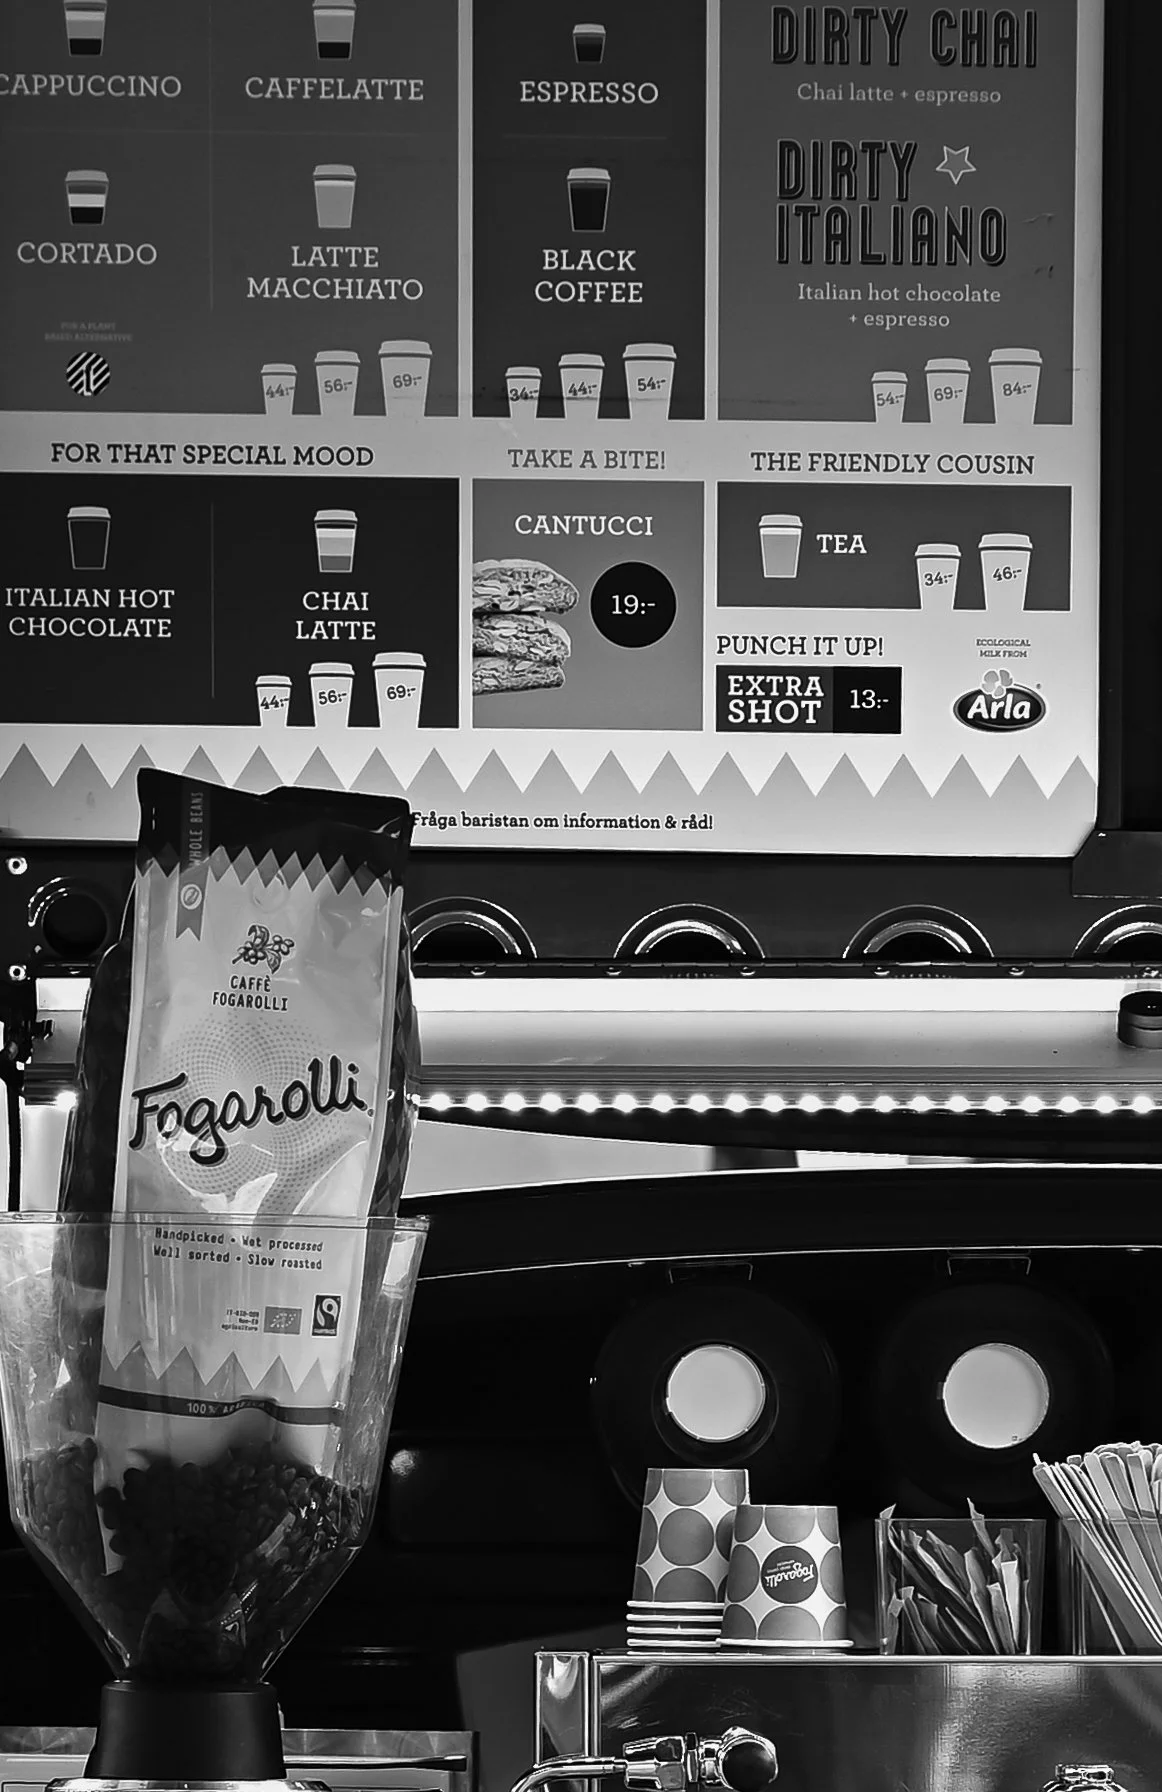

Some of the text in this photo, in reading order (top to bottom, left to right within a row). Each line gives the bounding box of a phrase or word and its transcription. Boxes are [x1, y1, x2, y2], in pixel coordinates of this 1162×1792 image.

[772, 6, 1038, 69] DIRTY CHAI
[0, 73, 182, 98] CAPPUCCINO
[245, 76, 424, 101] CAFFELATTE
[519, 80, 659, 104] ESPRESSO
[797, 81, 1002, 107] Chai latte + espresso
[778, 140, 918, 203] DIRTY
[777, 204, 1007, 268] ITALIANO
[17, 241, 158, 265] CORTADO
[291, 245, 379, 268] LATTE
[542, 249, 636, 272] BLACK
[247, 277, 424, 301] MACCHIATO
[534, 280, 643, 303] COFFEE
[798, 281, 1001, 303] Italian hot chocolate
[849, 314, 950, 331] + espresso
[324, 378, 352, 393] 56:-
[392, 373, 422, 389] 69:-
[568, 382, 597, 396] 44:-
[637, 377, 666, 392] 54:-
[876, 381, 1032, 407] 54:- 69:- 84:-
[51, 442, 374, 467] FOR THAT SPECIAL MOOD
[507, 448, 665, 470] TAKE A BITE!
[750, 451, 1035, 475] THE FRIENDLY COUSIN
[514, 514, 653, 536] CANTUCCI
[816, 534, 867, 554] TEA
[923, 563, 1022, 587] 34:- 46:-
[5, 587, 175, 609] ITALIAN HOT
[302, 591, 369, 611] CHAI
[612, 594, 656, 615] 19:-
[9, 616, 172, 638] CHOCOLATE
[295, 620, 376, 641] LATTE
[716, 635, 883, 657] PUNCH IT UP!
[260, 684, 417, 712] 44:- 56:- 69:-
[727, 675, 825, 701] EXTRA
[850, 689, 889, 709] 13:-
[727, 698, 822, 724] SHOT
[967, 693, 1031, 719] Arla
[412, 810, 714, 831] Fråga baristan om information & råd!
[229, 974, 271, 992] CAFFÈ
[212, 991, 288, 1012] FOGAROLLI
[128, 1055, 369, 1167] Fogarolli
[155, 1227, 225, 1244] Handpicked
[269, 1238, 323, 1252] processed
[153, 1245, 322, 1270] Well sorted Slow roasted
